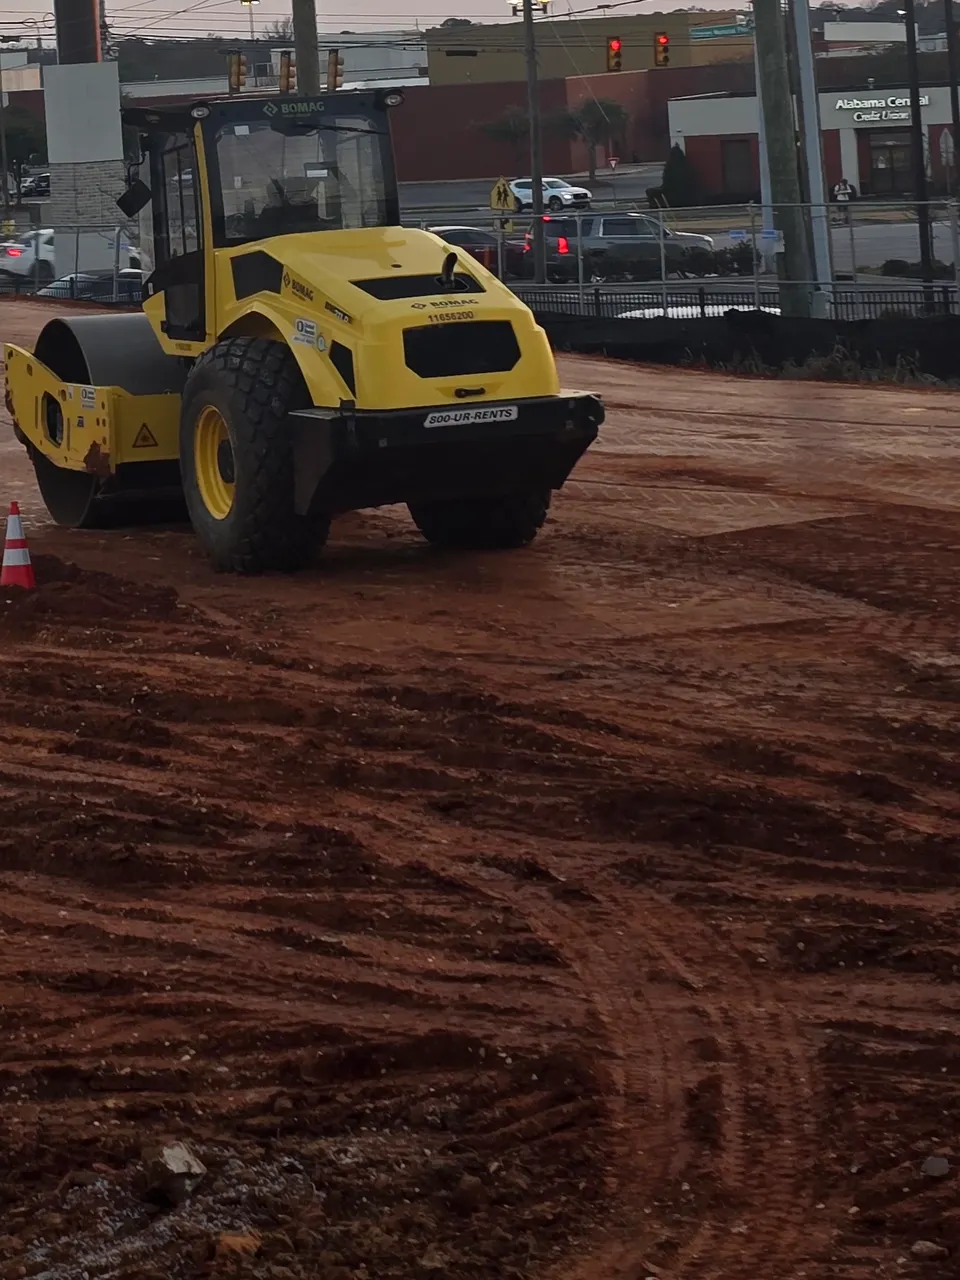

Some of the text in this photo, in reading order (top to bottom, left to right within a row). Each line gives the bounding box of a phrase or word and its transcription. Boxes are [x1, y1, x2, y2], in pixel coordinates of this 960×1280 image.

[281, 101, 325, 113] BOMAG
[835, 96, 929, 109] Alabama Cenal
[853, 110, 909, 122] Credit Union
[291, 280, 314, 301] BOMAG
[429, 299, 479, 307] BOMAG
